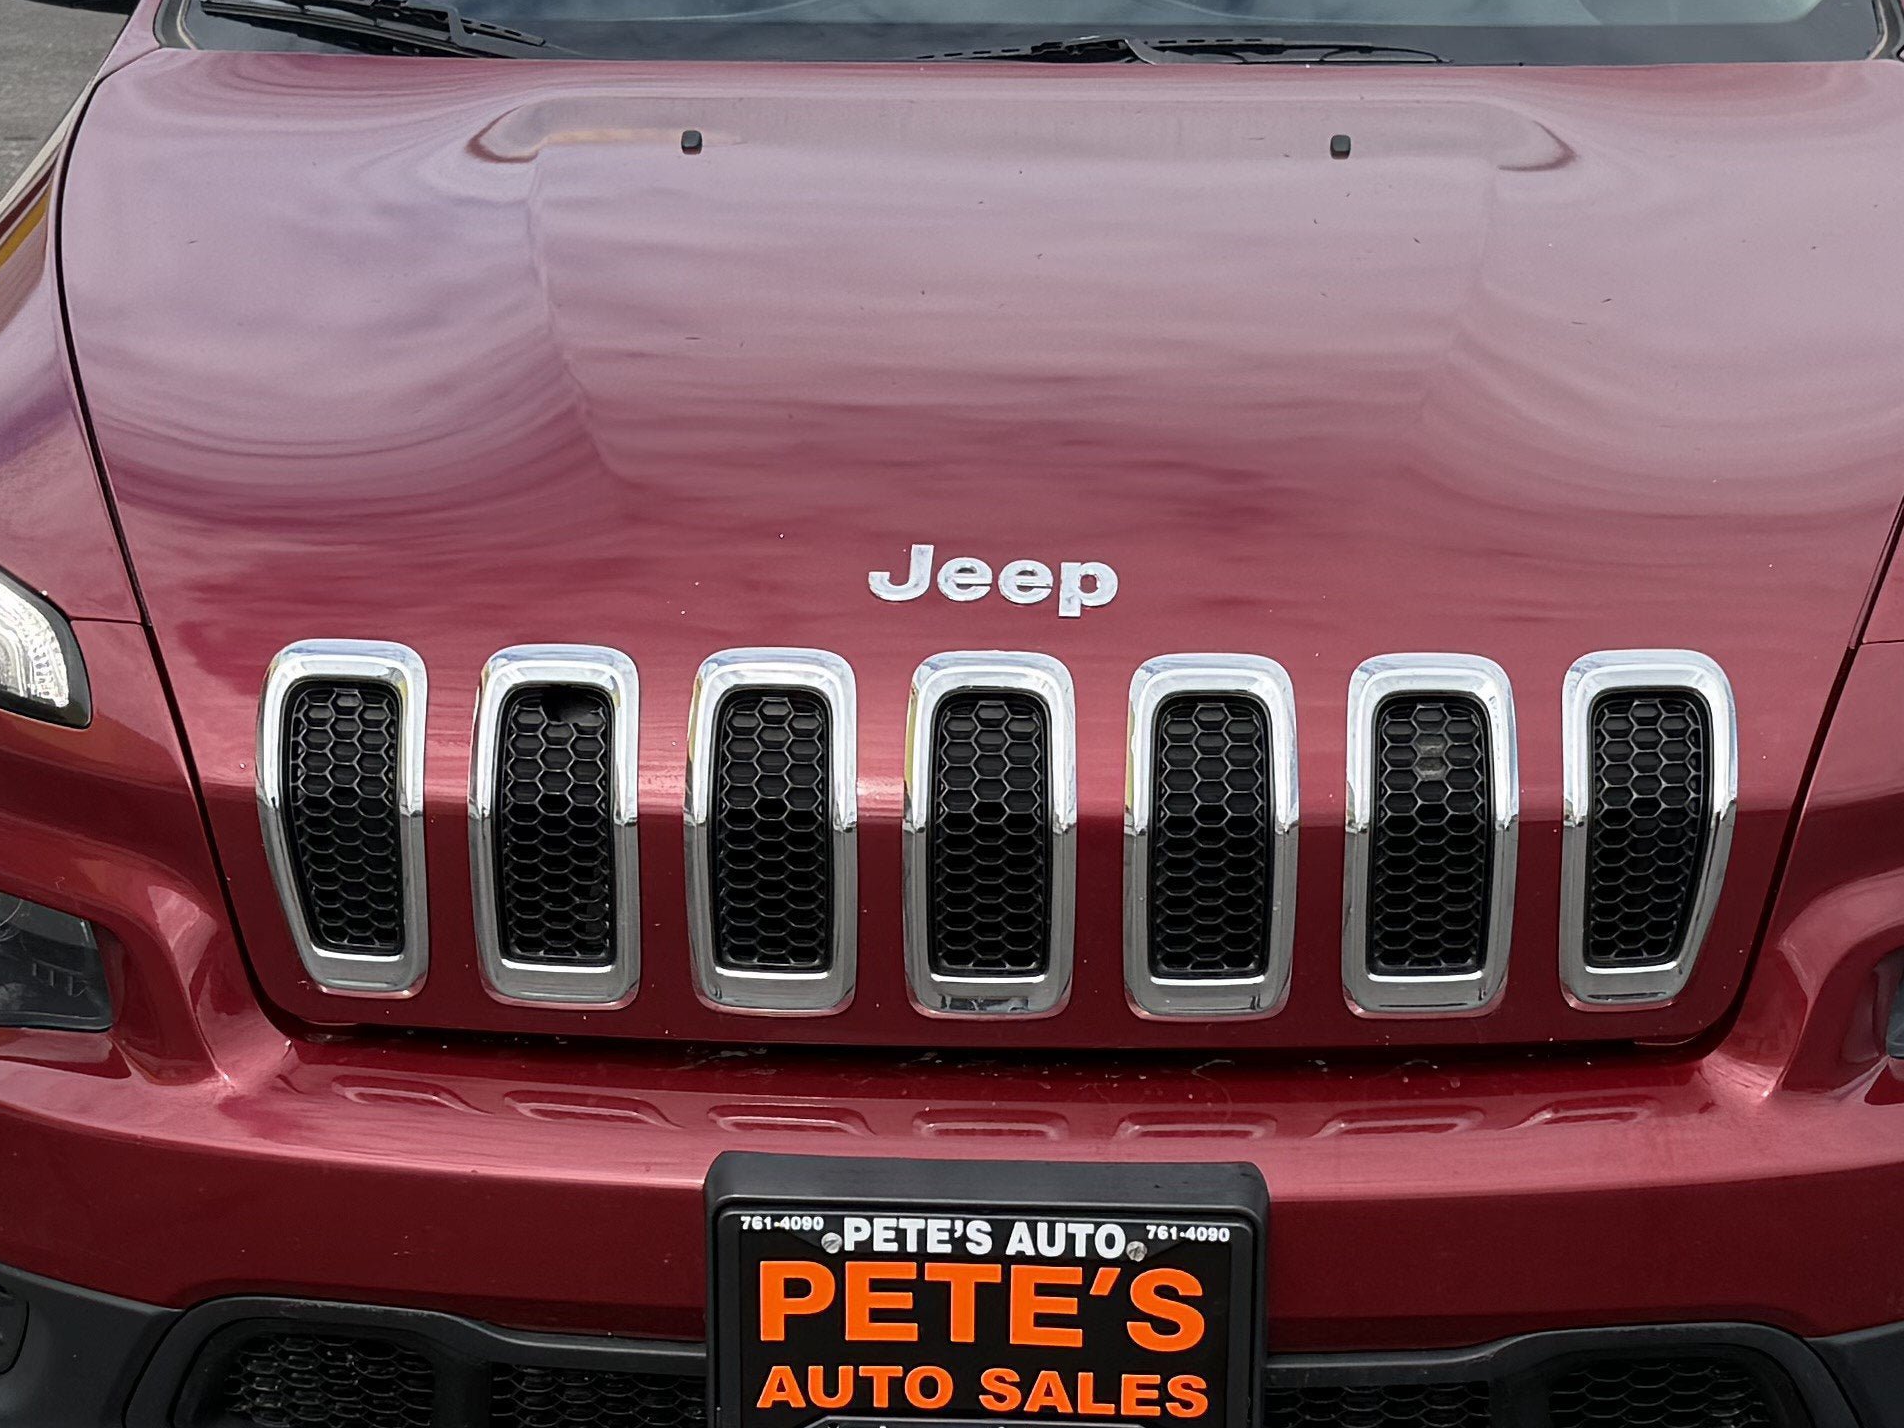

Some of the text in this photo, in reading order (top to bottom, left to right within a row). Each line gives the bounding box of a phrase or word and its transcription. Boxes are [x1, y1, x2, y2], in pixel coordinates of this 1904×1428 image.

[868, 544, 1119, 618] Jeep
[843, 1217, 1127, 1259] PETE'S AUTO
[759, 1260, 1206, 1353] PETE'S
[757, 1365, 1210, 1419] AUTO SALES
